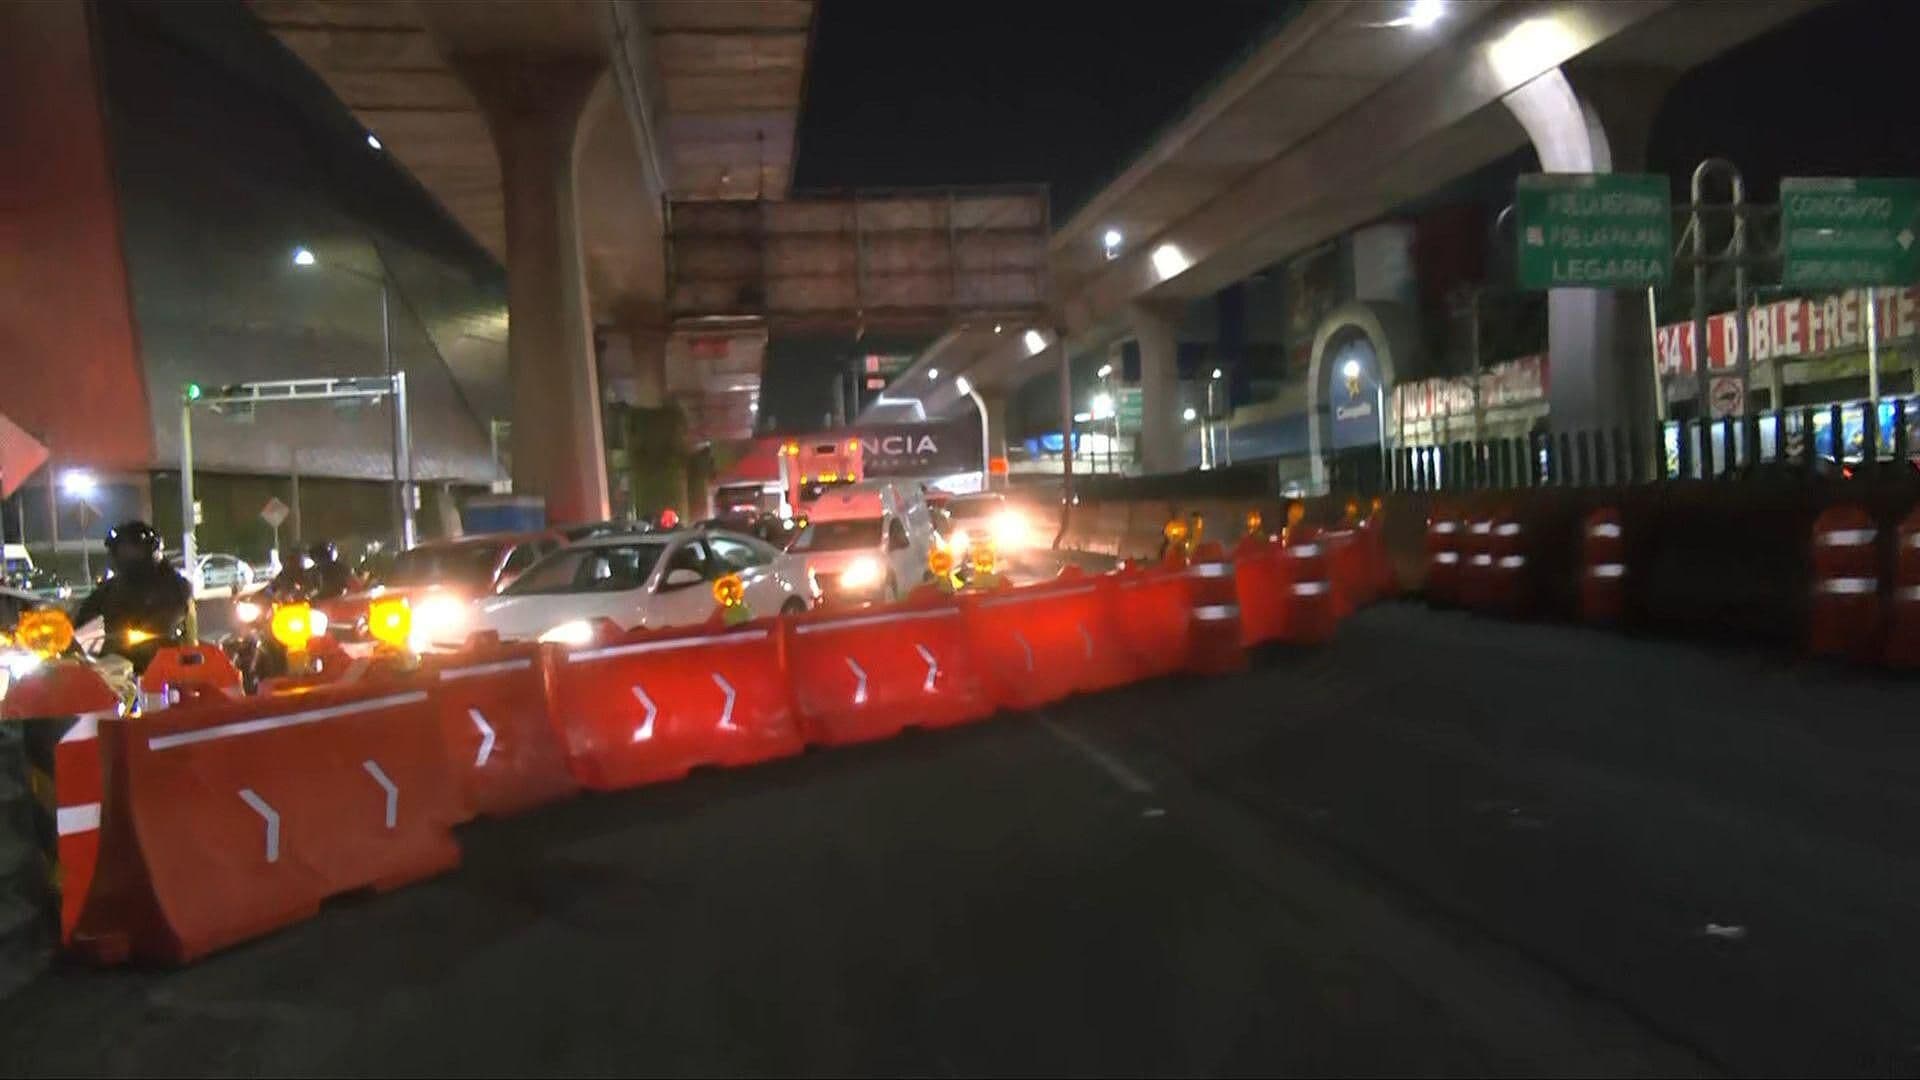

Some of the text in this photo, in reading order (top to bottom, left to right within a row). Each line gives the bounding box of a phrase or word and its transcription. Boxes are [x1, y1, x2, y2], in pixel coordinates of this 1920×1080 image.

[1552, 258, 1665, 281] LEGARIA
[1724, 297, 1801, 367] DBLE
[861, 434, 938, 455] NCIA
